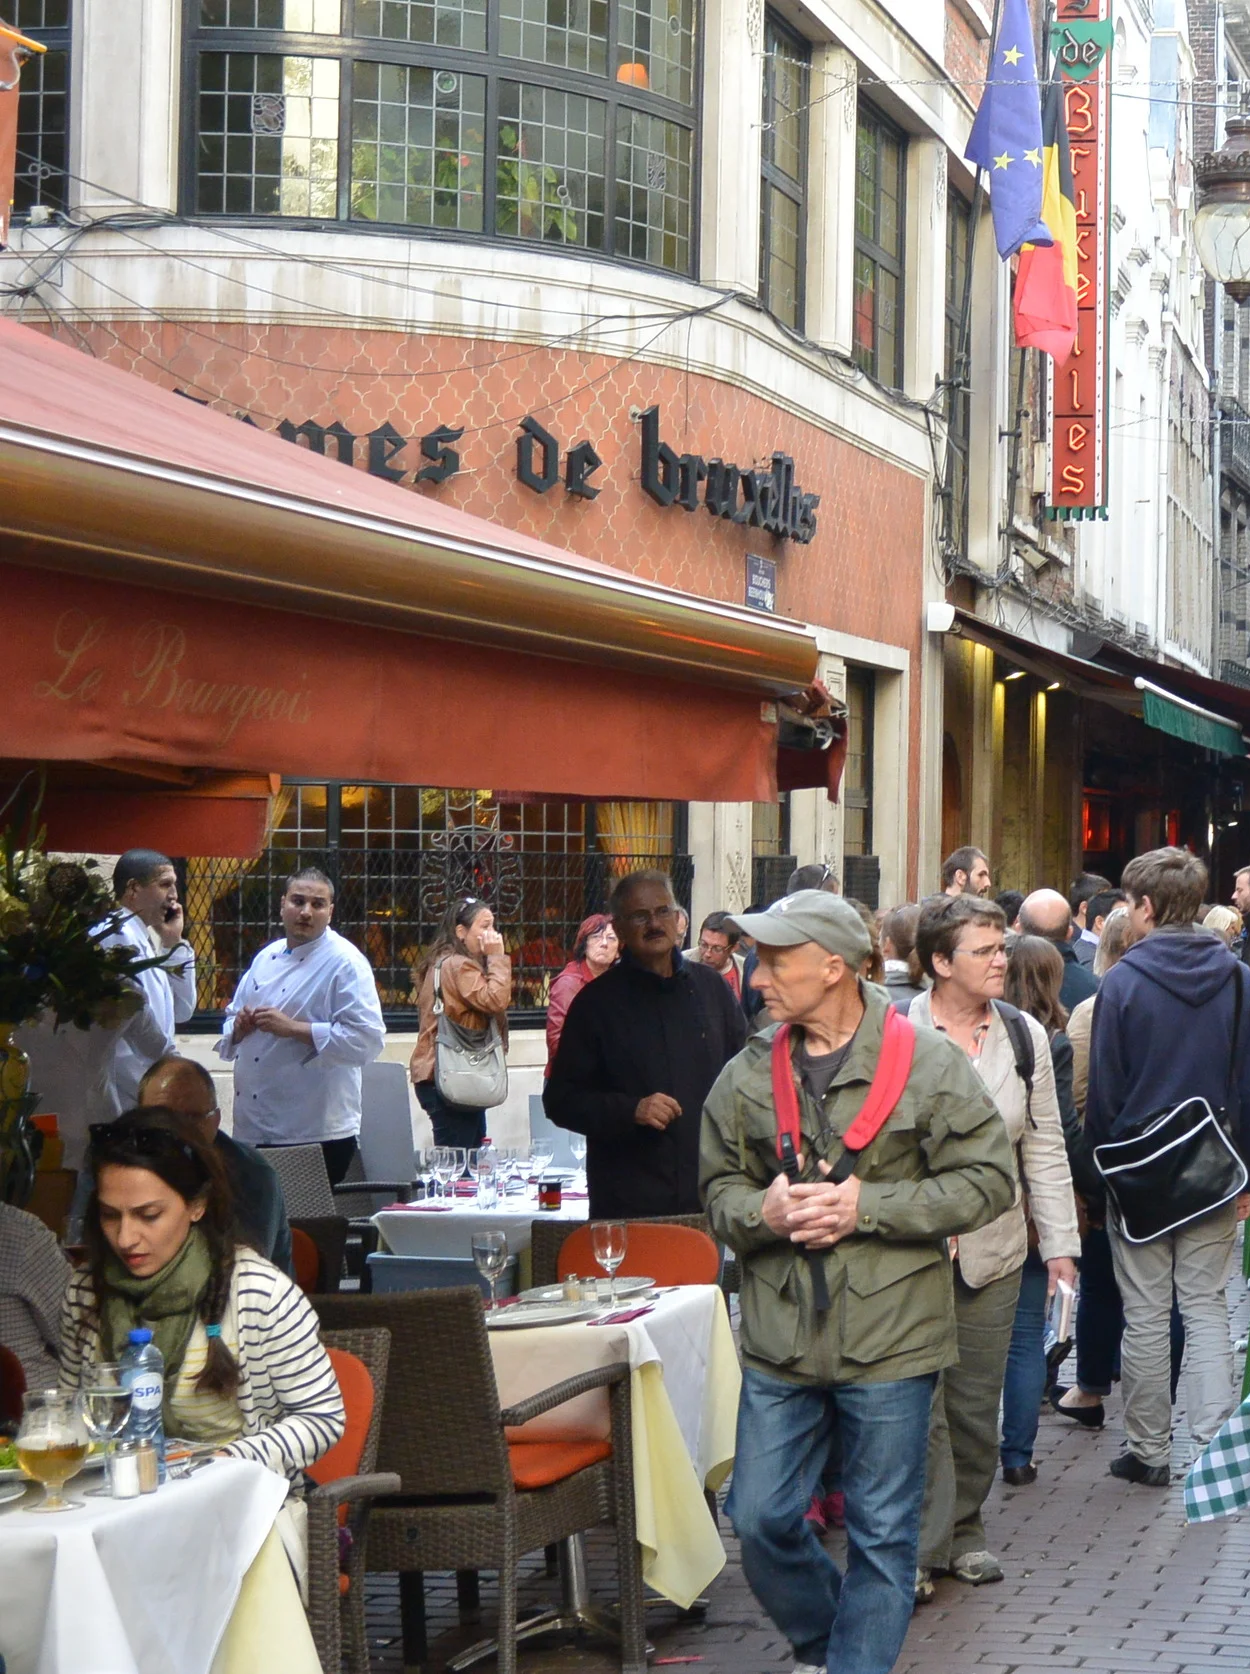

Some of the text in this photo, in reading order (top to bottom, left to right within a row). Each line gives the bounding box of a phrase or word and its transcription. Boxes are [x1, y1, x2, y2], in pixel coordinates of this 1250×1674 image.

[1062, 28, 1101, 68] de
[515, 415, 602, 500] de
[637, 404, 820, 545] bruxelles
[34, 606, 313, 750] Le Bourgeois
[133, 1385, 162, 1398] SPA
